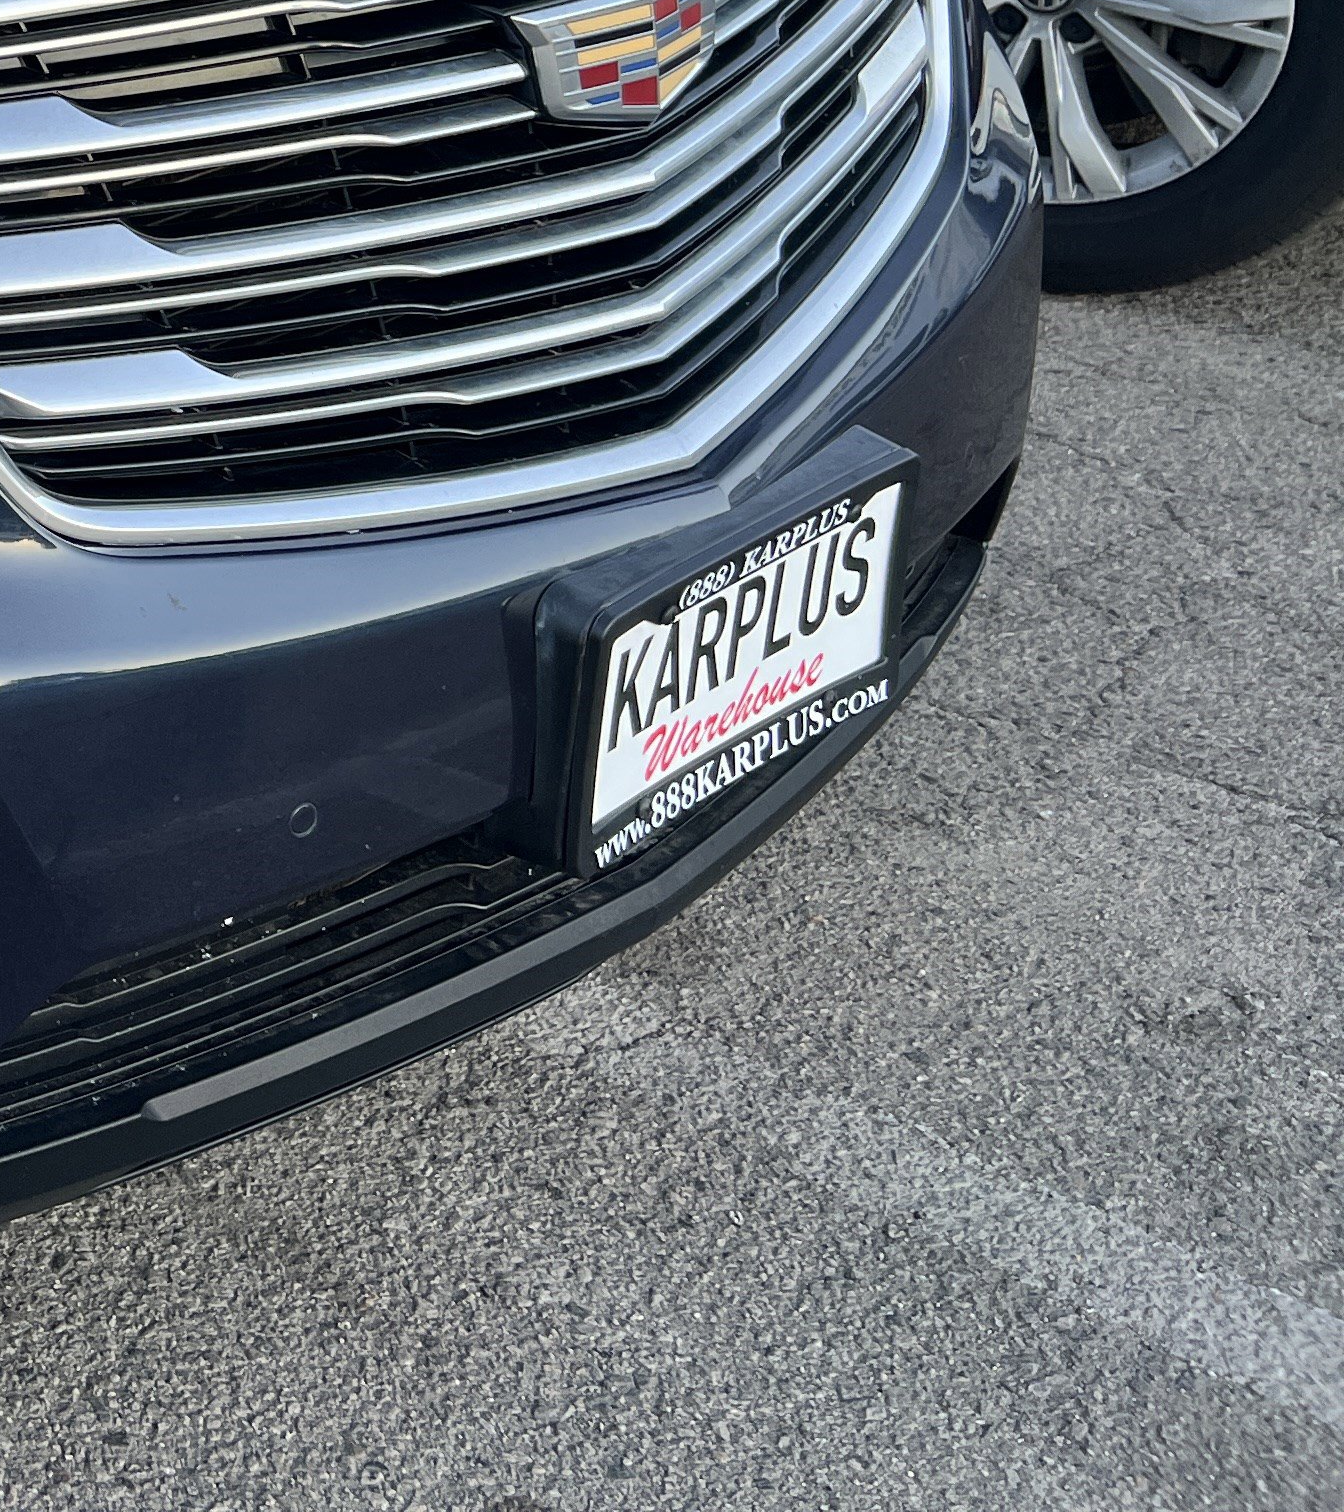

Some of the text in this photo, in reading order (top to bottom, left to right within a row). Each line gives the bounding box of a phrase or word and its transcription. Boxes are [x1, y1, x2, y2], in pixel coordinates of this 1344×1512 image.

[678, 498, 851, 610] (888) KARPLUS
[607, 517, 876, 754] KARPLUS
[642, 652, 825, 783] Warehouse
